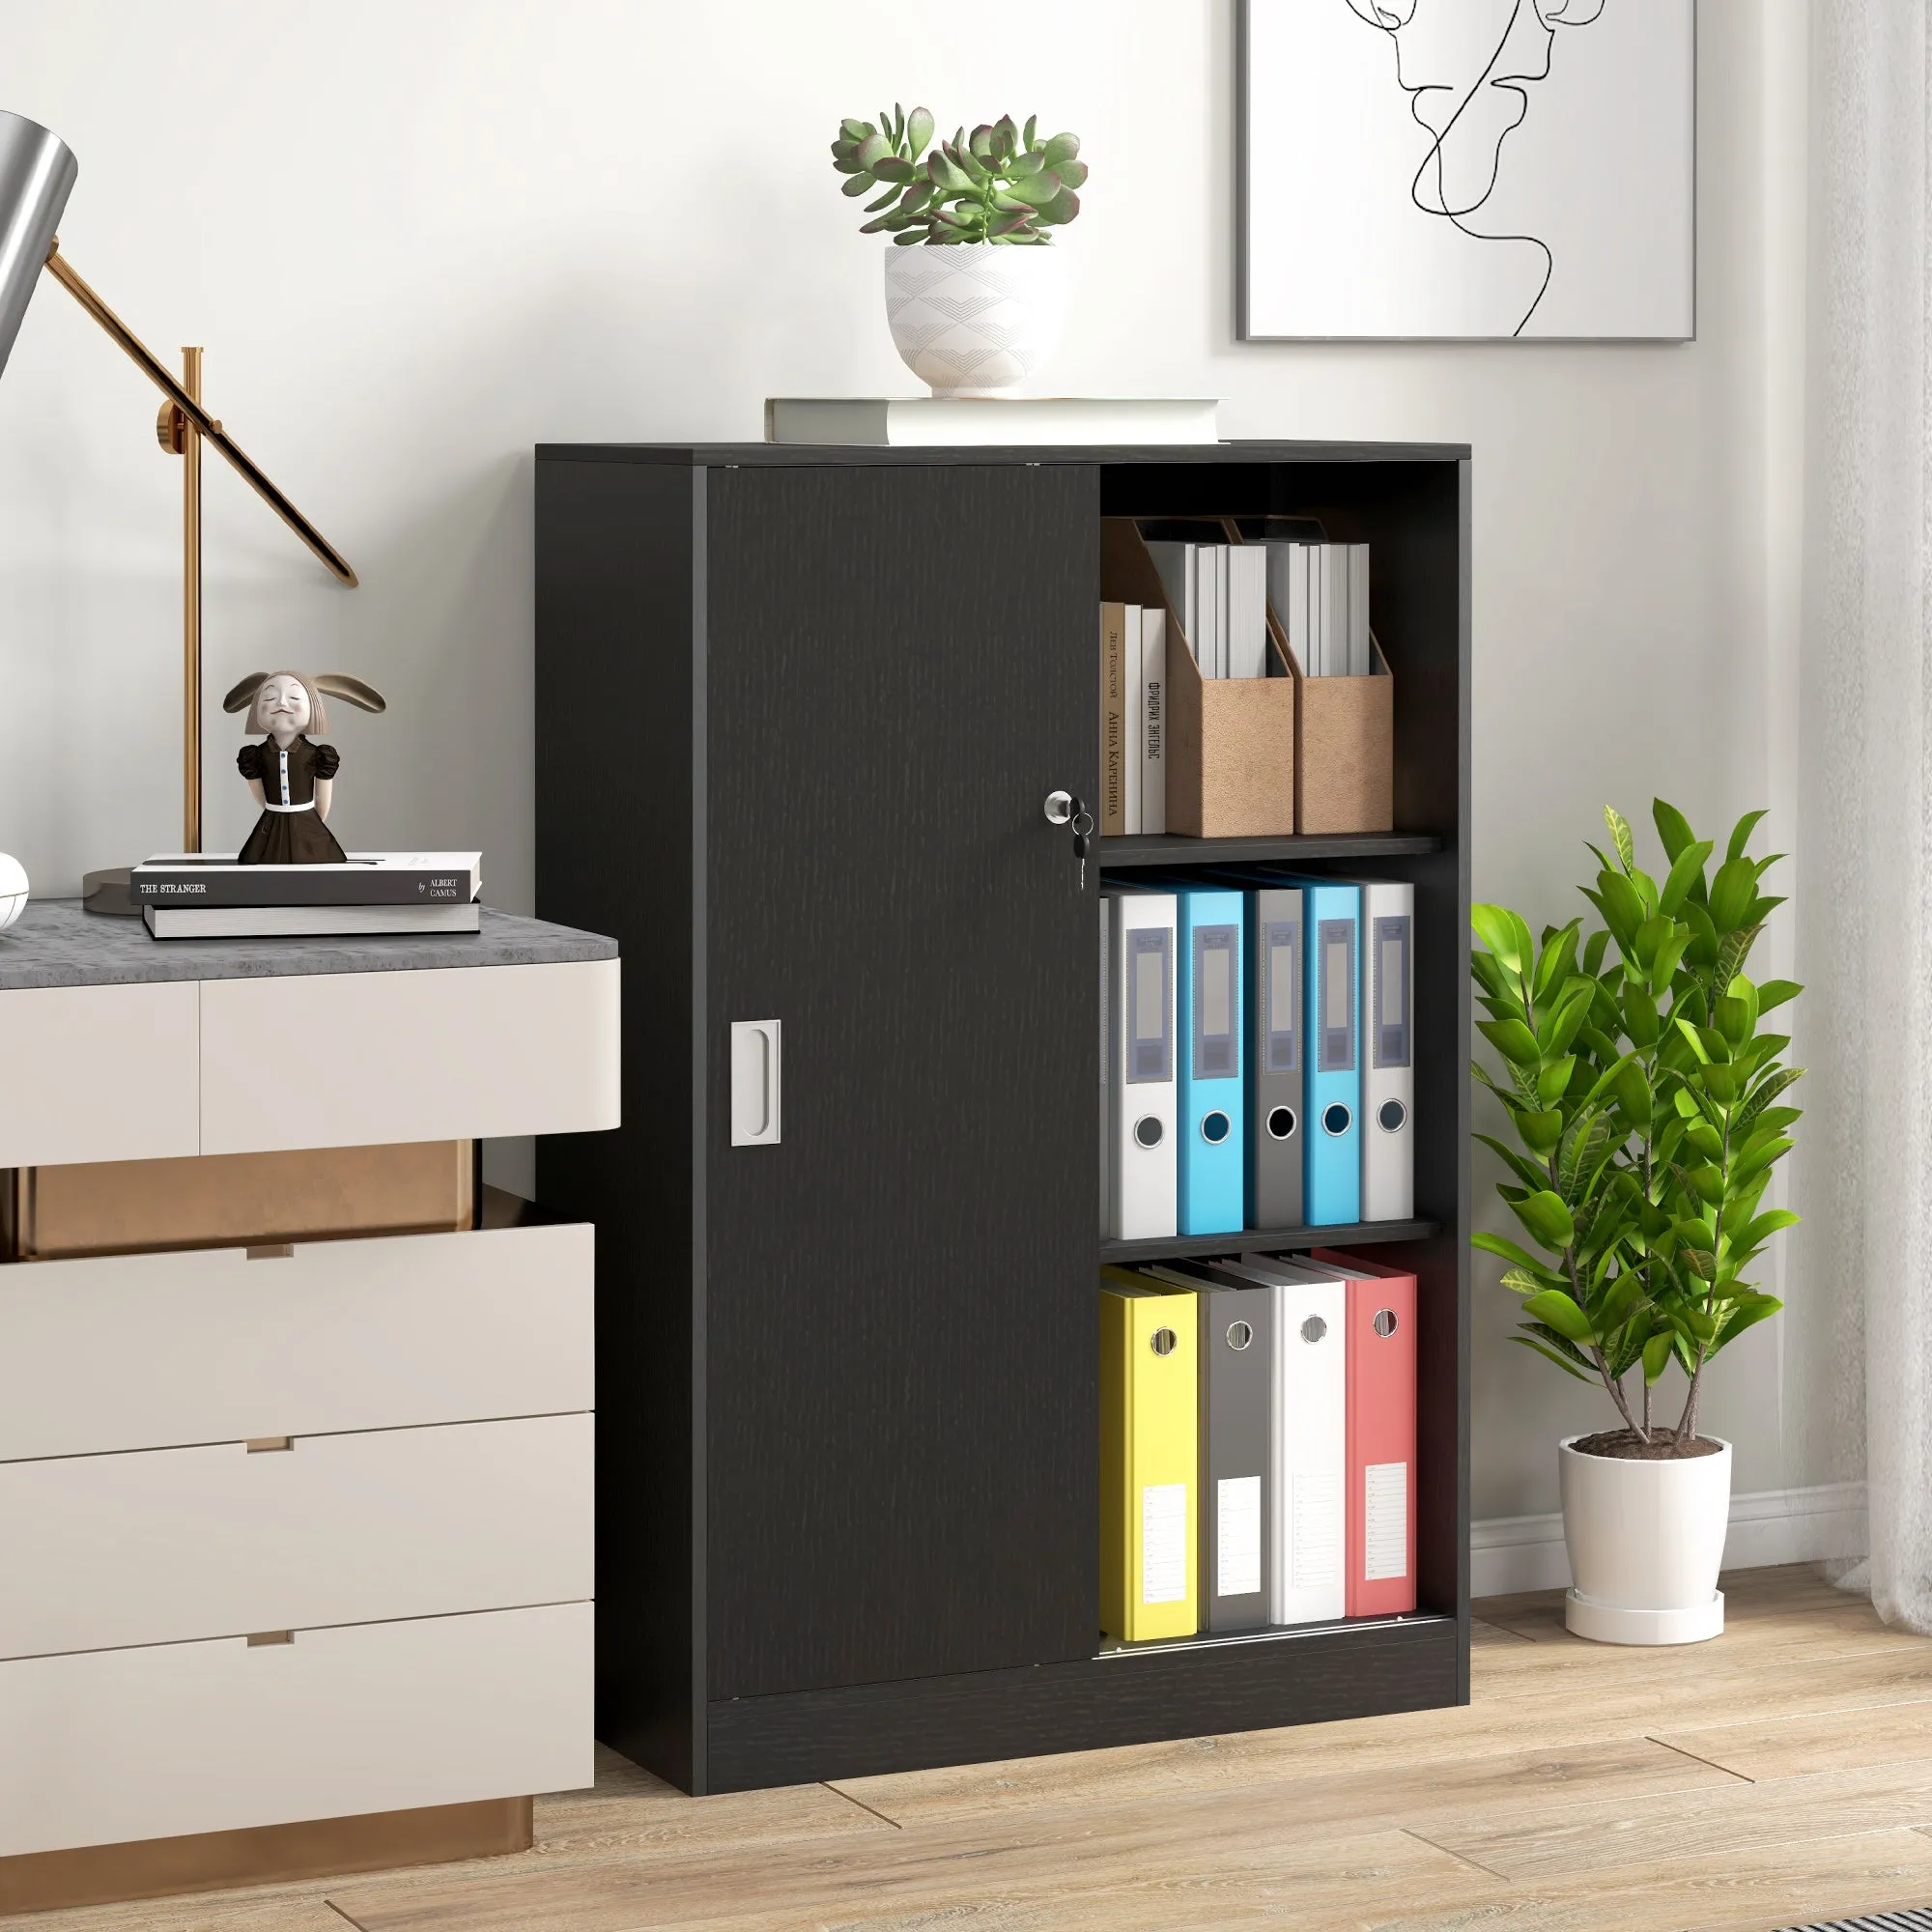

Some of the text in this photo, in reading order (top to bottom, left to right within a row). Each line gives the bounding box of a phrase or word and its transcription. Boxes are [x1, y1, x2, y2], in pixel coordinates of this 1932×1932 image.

[1148, 682, 1160, 759] ФРИДРИХ ЭНГЕЛЬС
[417, 881, 426, 894] by
[430, 878, 458, 887] ALBERT
[139, 884, 207, 894] THE STRANGER
[430, 889, 457, 897] CAMUS
